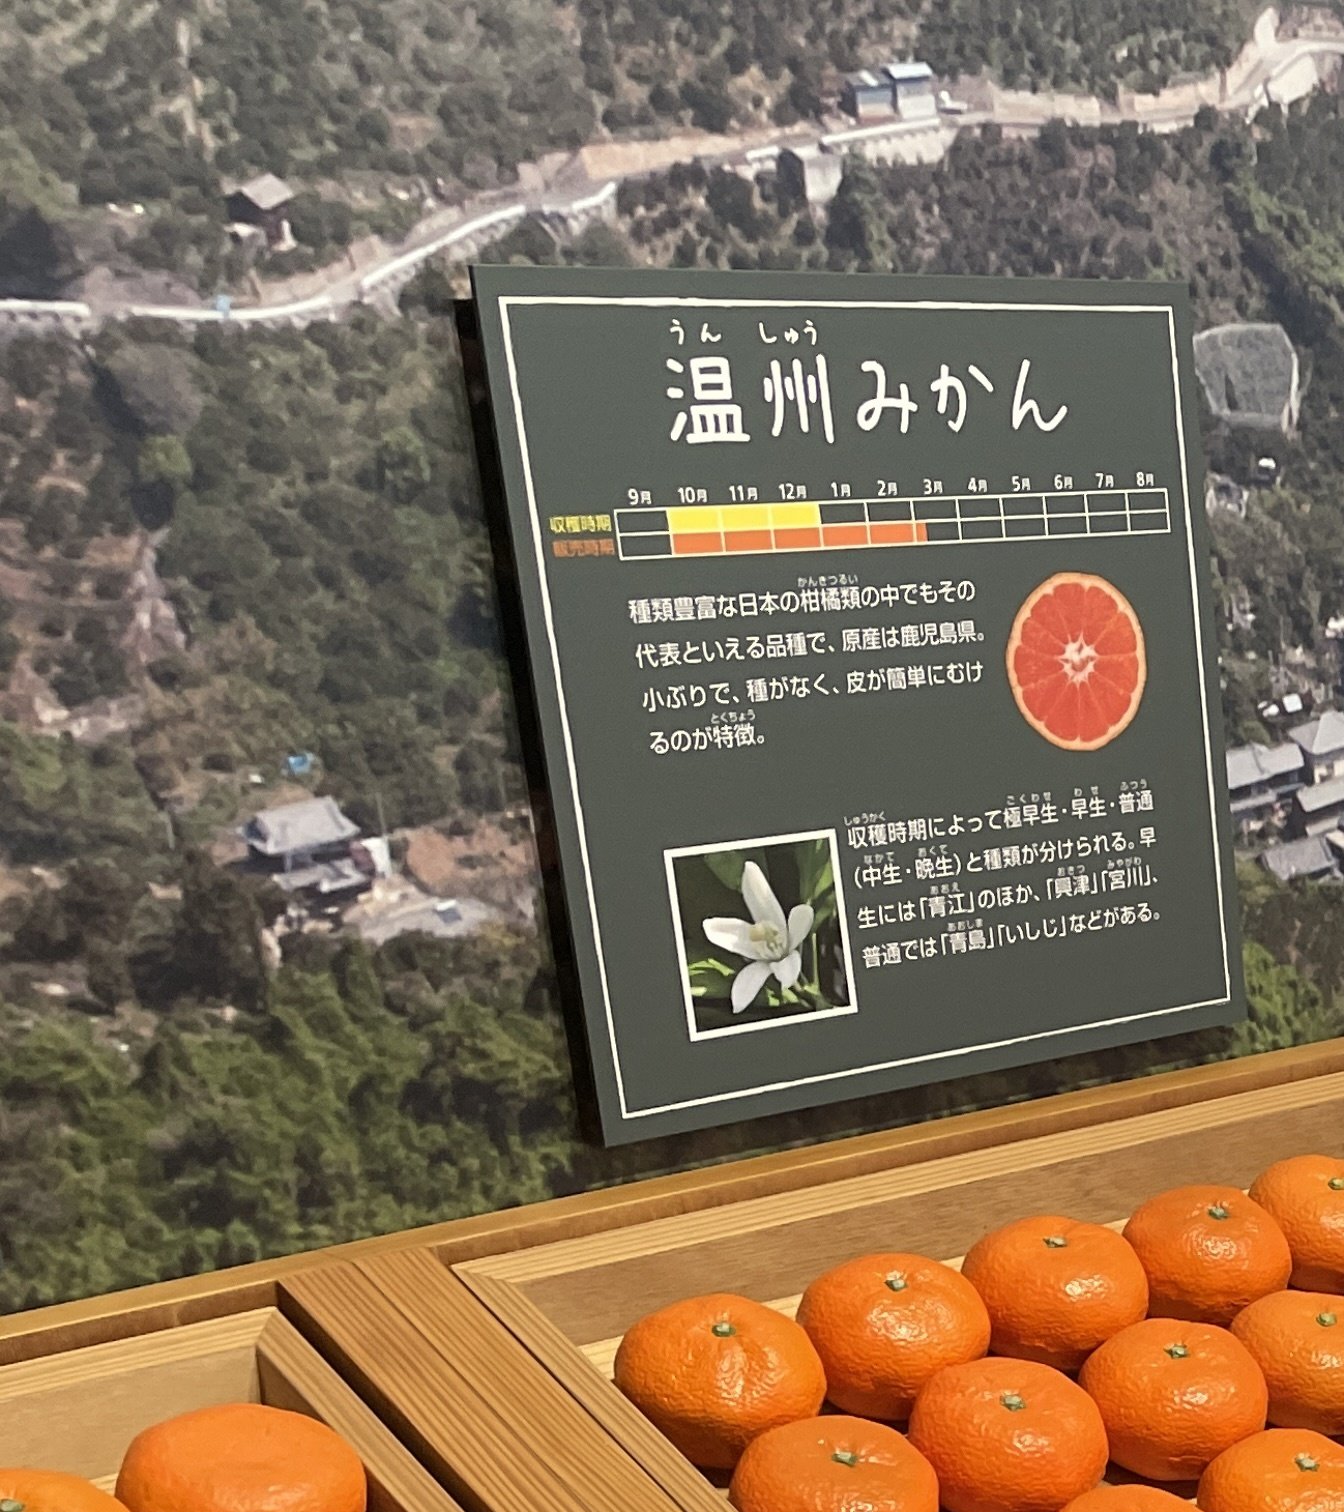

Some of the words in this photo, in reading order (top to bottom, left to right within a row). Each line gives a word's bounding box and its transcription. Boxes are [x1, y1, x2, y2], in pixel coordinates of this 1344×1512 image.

[666, 319, 721, 343] うん
[760, 319, 819, 344] しゅう
[666, 353, 1069, 445] 温州みかん
[627, 488, 651, 505] 9月
[677, 486, 708, 503] 10月
[728, 484, 758, 501] 11月
[778, 482, 807, 499] 12月
[830, 482, 851, 497] 1月
[876, 480, 898, 497] 2月
[922, 478, 943, 495] 3月
[967, 477, 988, 493] 4月
[1011, 475, 1031, 492] 5月
[1054, 474, 1073, 490] 6月
[1094, 472, 1114, 489] 7月
[1135, 471, 1154, 487] 8月
[628, 580, 976, 624] 種類豊富な日本の柑橘類の中でもその
[635, 620, 985, 669] 代表といえる品種で、原産は鹿児島県。
[642, 660, 984, 713] 小ぶりで、種がなく、皮が簡単にむけ
[649, 722, 766, 755] るのが特徴。
